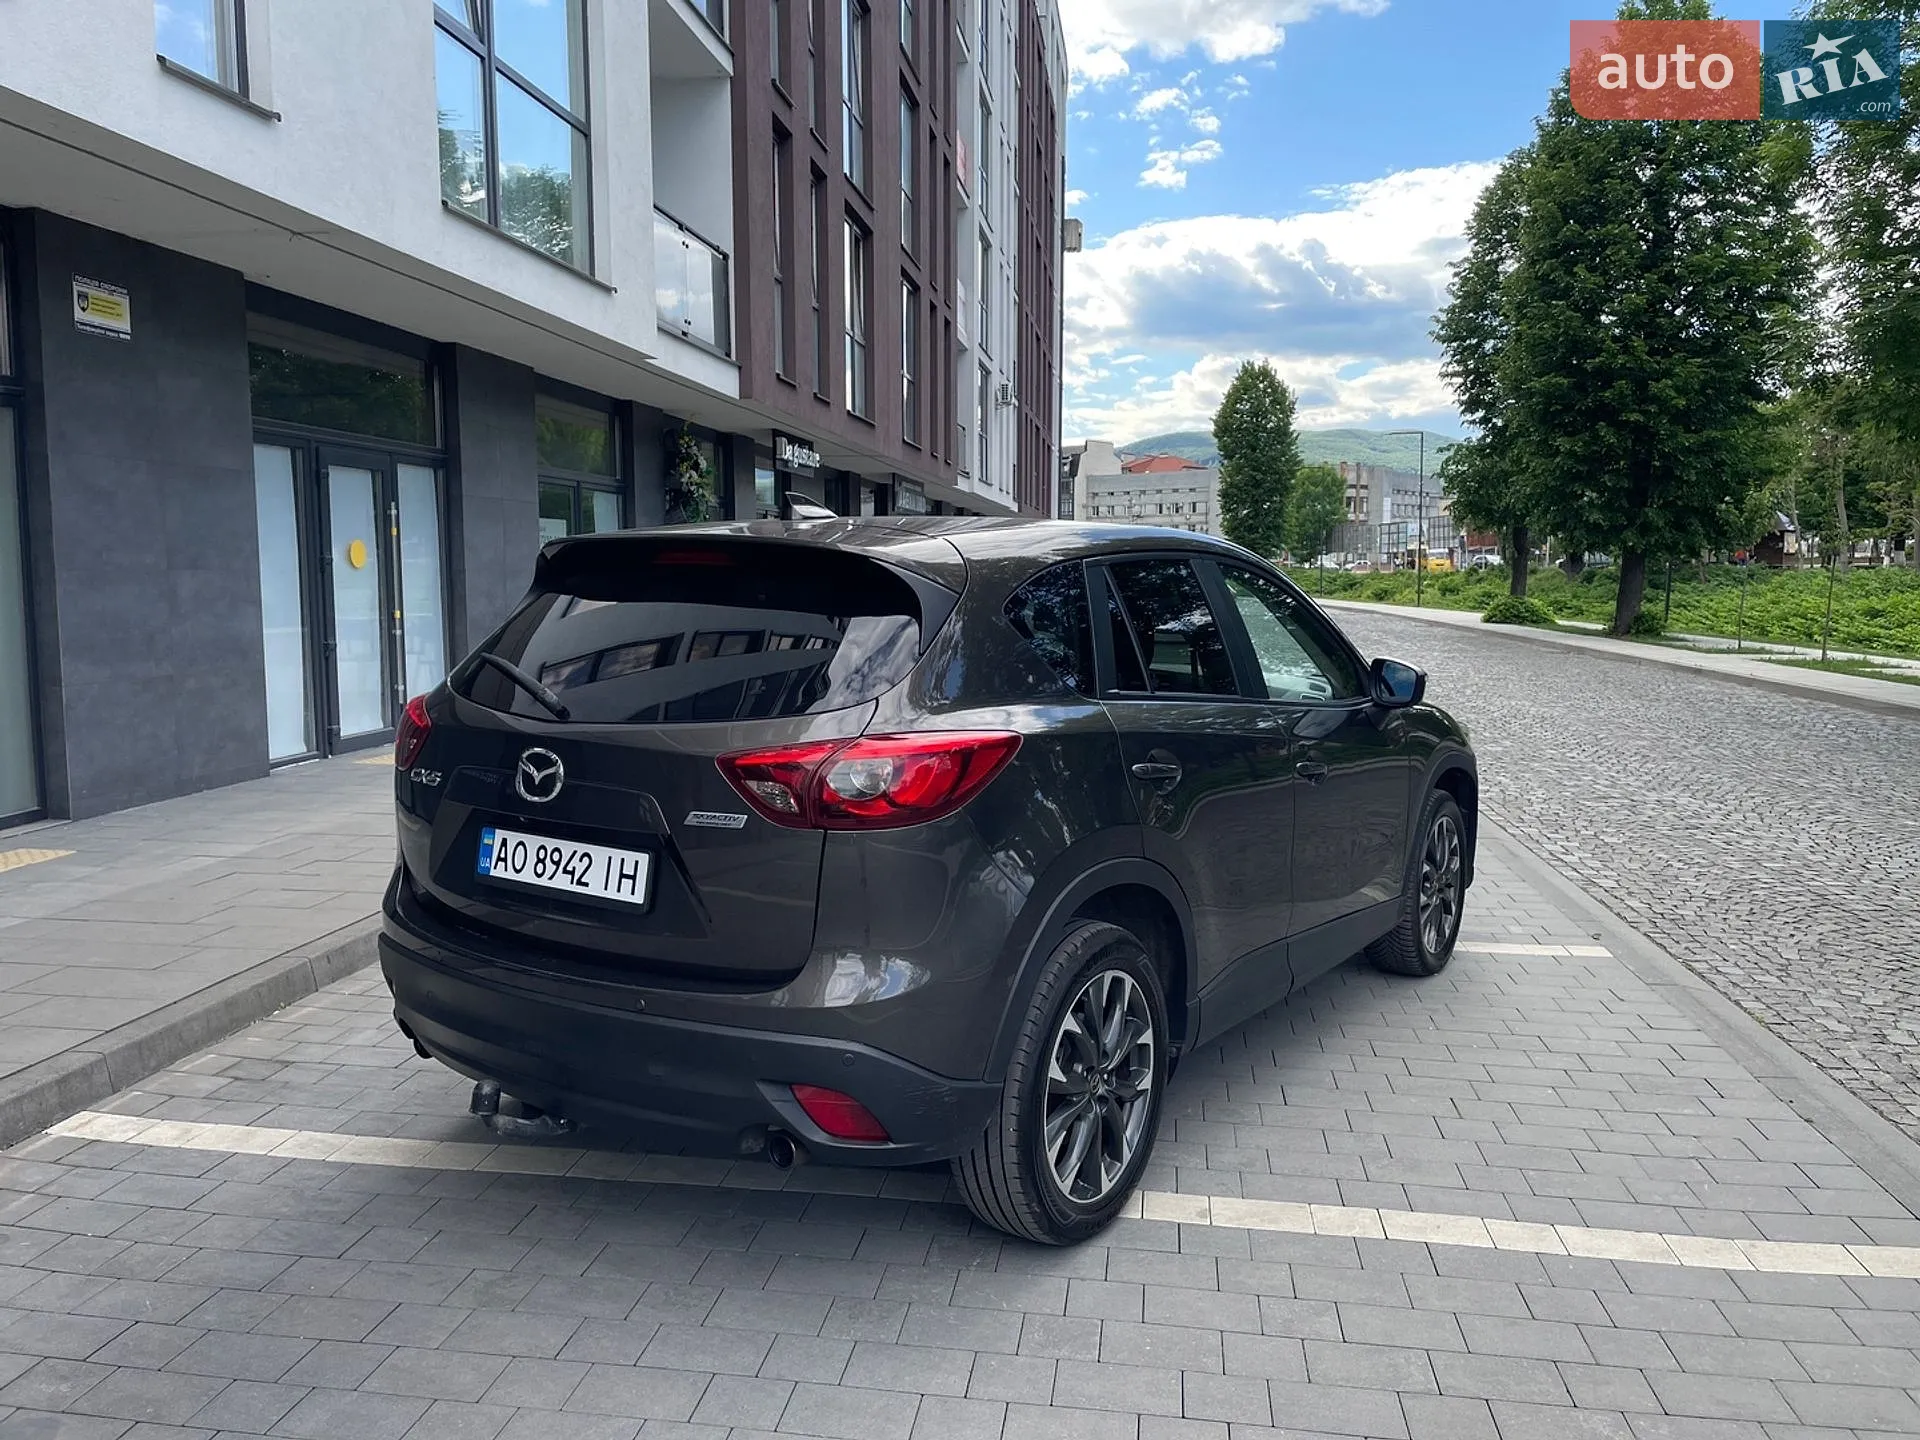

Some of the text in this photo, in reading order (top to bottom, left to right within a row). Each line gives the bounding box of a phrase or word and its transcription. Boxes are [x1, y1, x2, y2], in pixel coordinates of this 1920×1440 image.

[480, 857, 491, 869] UA
[493, 837, 640, 896] AO 8942 IH
